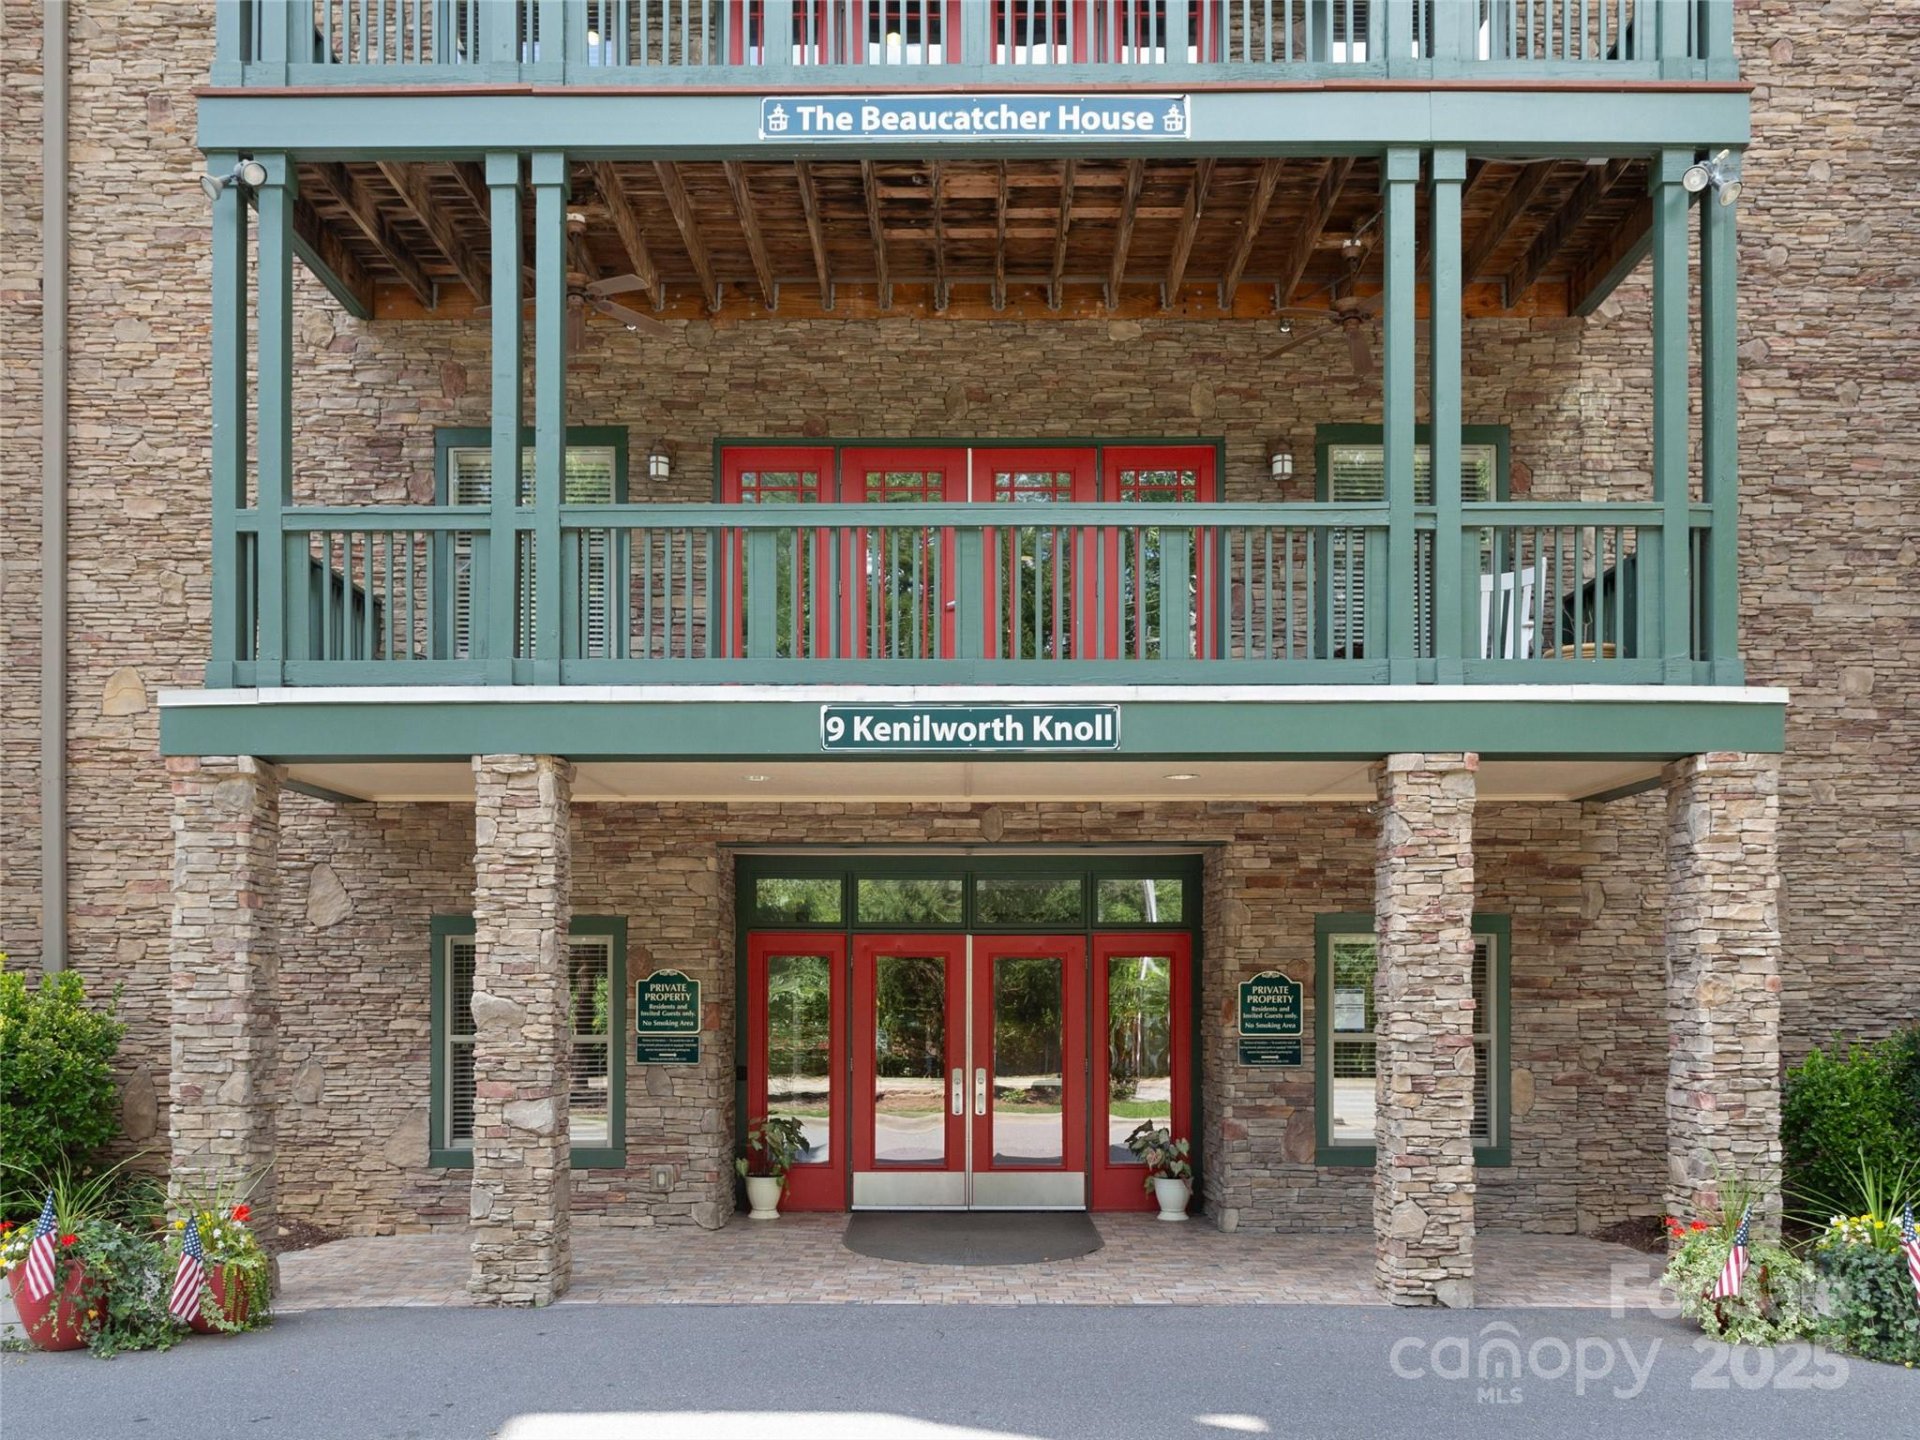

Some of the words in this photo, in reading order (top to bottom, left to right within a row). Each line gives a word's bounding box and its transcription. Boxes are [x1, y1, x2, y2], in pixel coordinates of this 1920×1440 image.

[797, 105, 853, 131] The
[861, 105, 1050, 131] Beaucatcher
[1059, 105, 1154, 131] House
[826, 716, 845, 742] 9
[854, 715, 1024, 742] Kenilworth
[1033, 714, 1112, 741] Knoll
[650, 984, 687, 992] PRIVATE
[1252, 986, 1289, 994] PRIVATE
[645, 993, 692, 1001] PROPERTY
[1247, 995, 1294, 1003] PROPERTY
[653, 1020, 679, 1028] Smoking
[1255, 1022, 1281, 1030] Smoking
